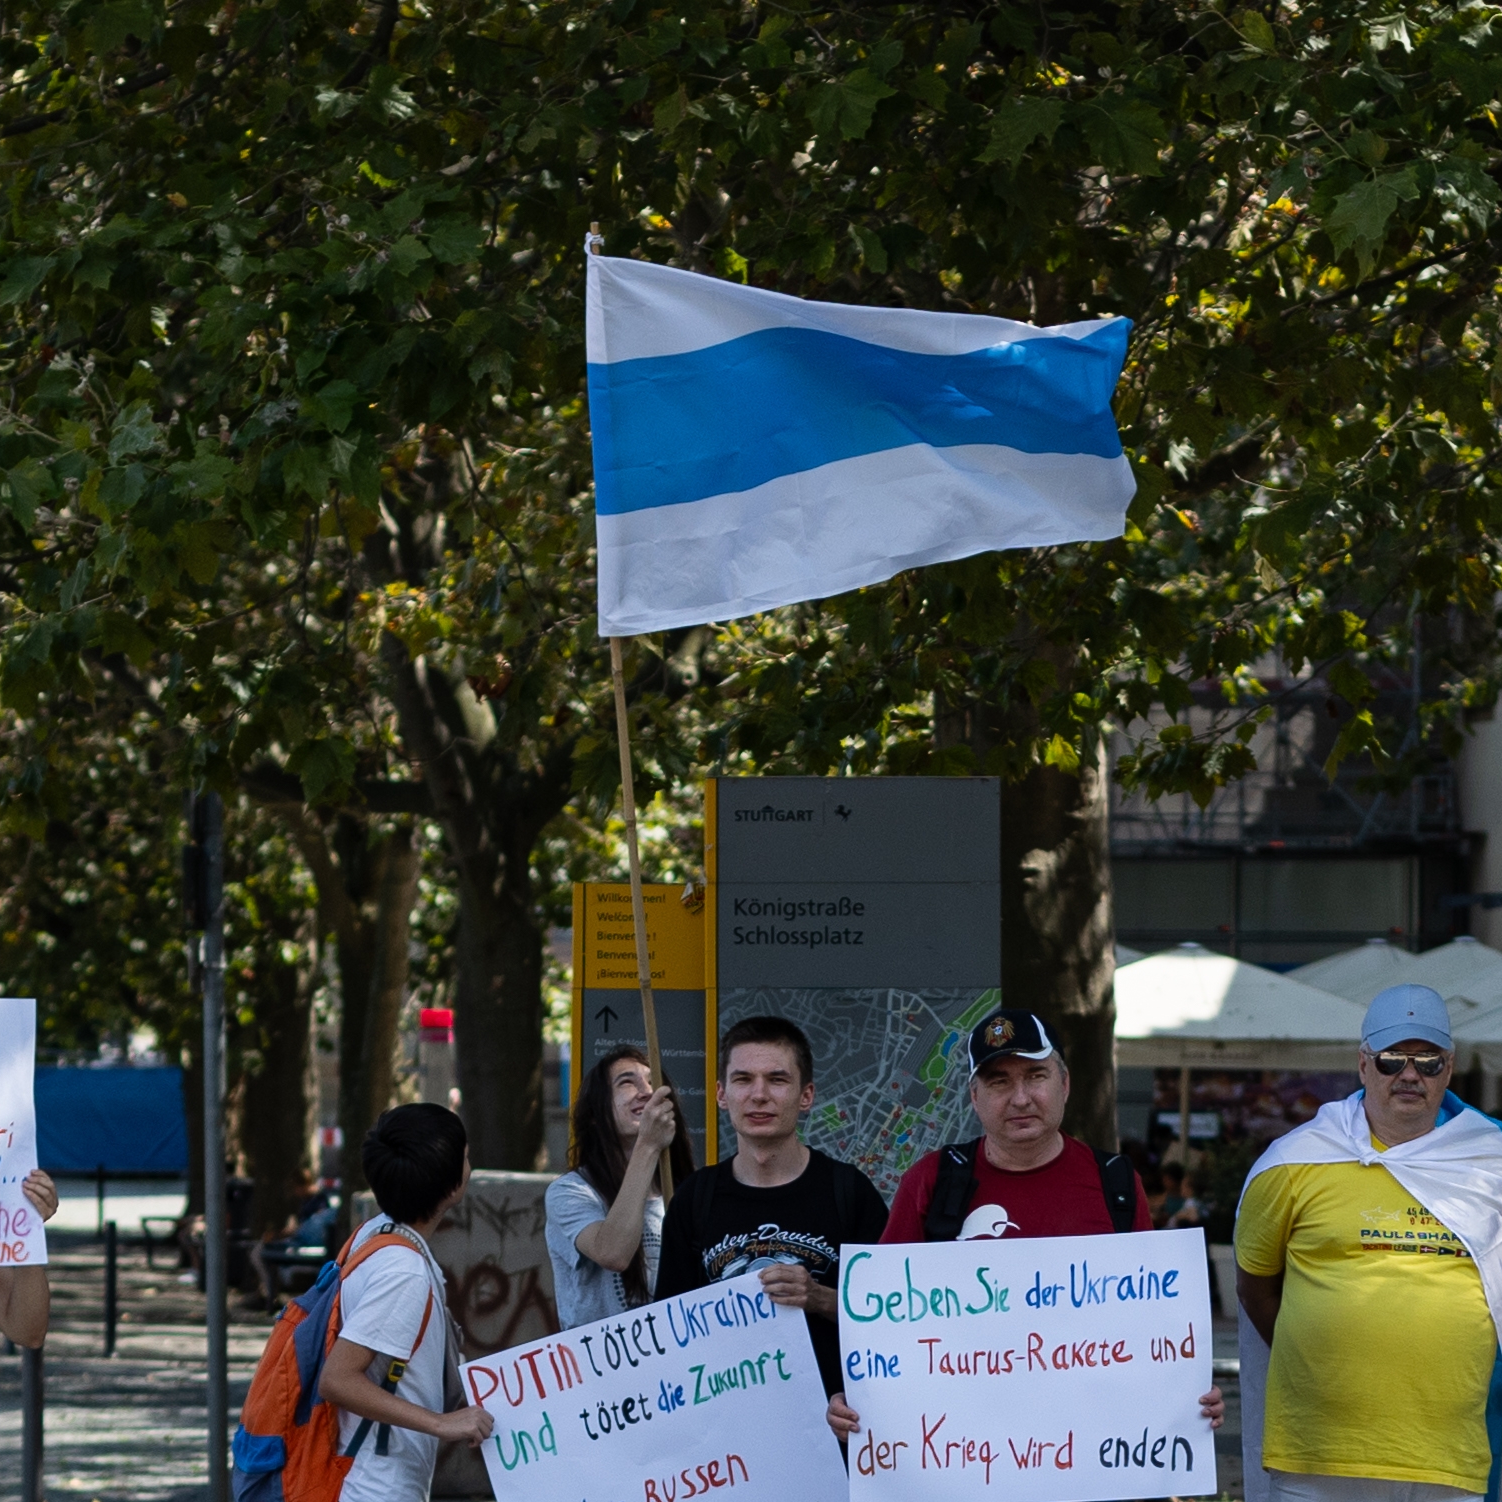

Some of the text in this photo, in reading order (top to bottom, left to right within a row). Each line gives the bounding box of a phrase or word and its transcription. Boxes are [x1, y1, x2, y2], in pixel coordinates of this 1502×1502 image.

[734, 805, 814, 822] STUTTGART
[733, 897, 865, 921] Königstraße
[733, 926, 864, 949] Schlossplatz
[842, 1250, 1180, 1324] Geben Sie der Ukraine
[579, 1311, 666, 1377] tötet
[846, 1321, 1196, 1382] eine Taurus-Rakete und
[579, 1392, 653, 1441] tötet
[657, 1379, 686, 1414] die
[688, 1348, 792, 1406] Zukunft
[856, 1428, 909, 1477] der
[921, 1412, 1000, 1485] Krieg
[1098, 1426, 1194, 1472] enden
